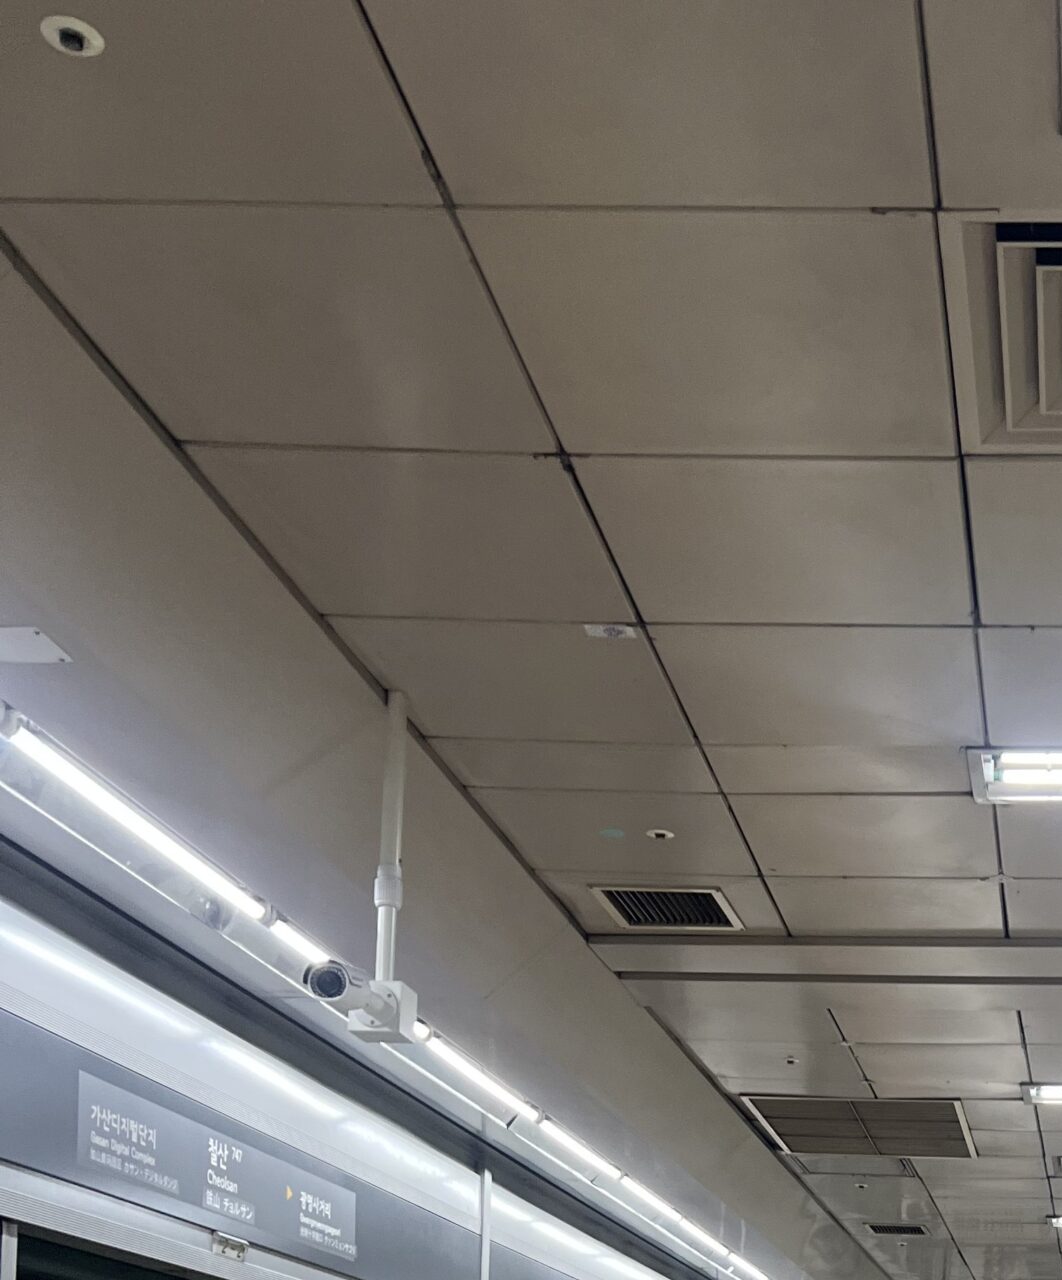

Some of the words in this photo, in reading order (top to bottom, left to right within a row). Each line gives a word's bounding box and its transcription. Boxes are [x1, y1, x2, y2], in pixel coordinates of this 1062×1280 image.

[91, 1105, 156, 1150] 가산디지털단지
[208, 1138, 228, 1170] 철산
[231, 1146, 243, 1163] 747
[207, 1169, 238, 1194] Cheolsan
